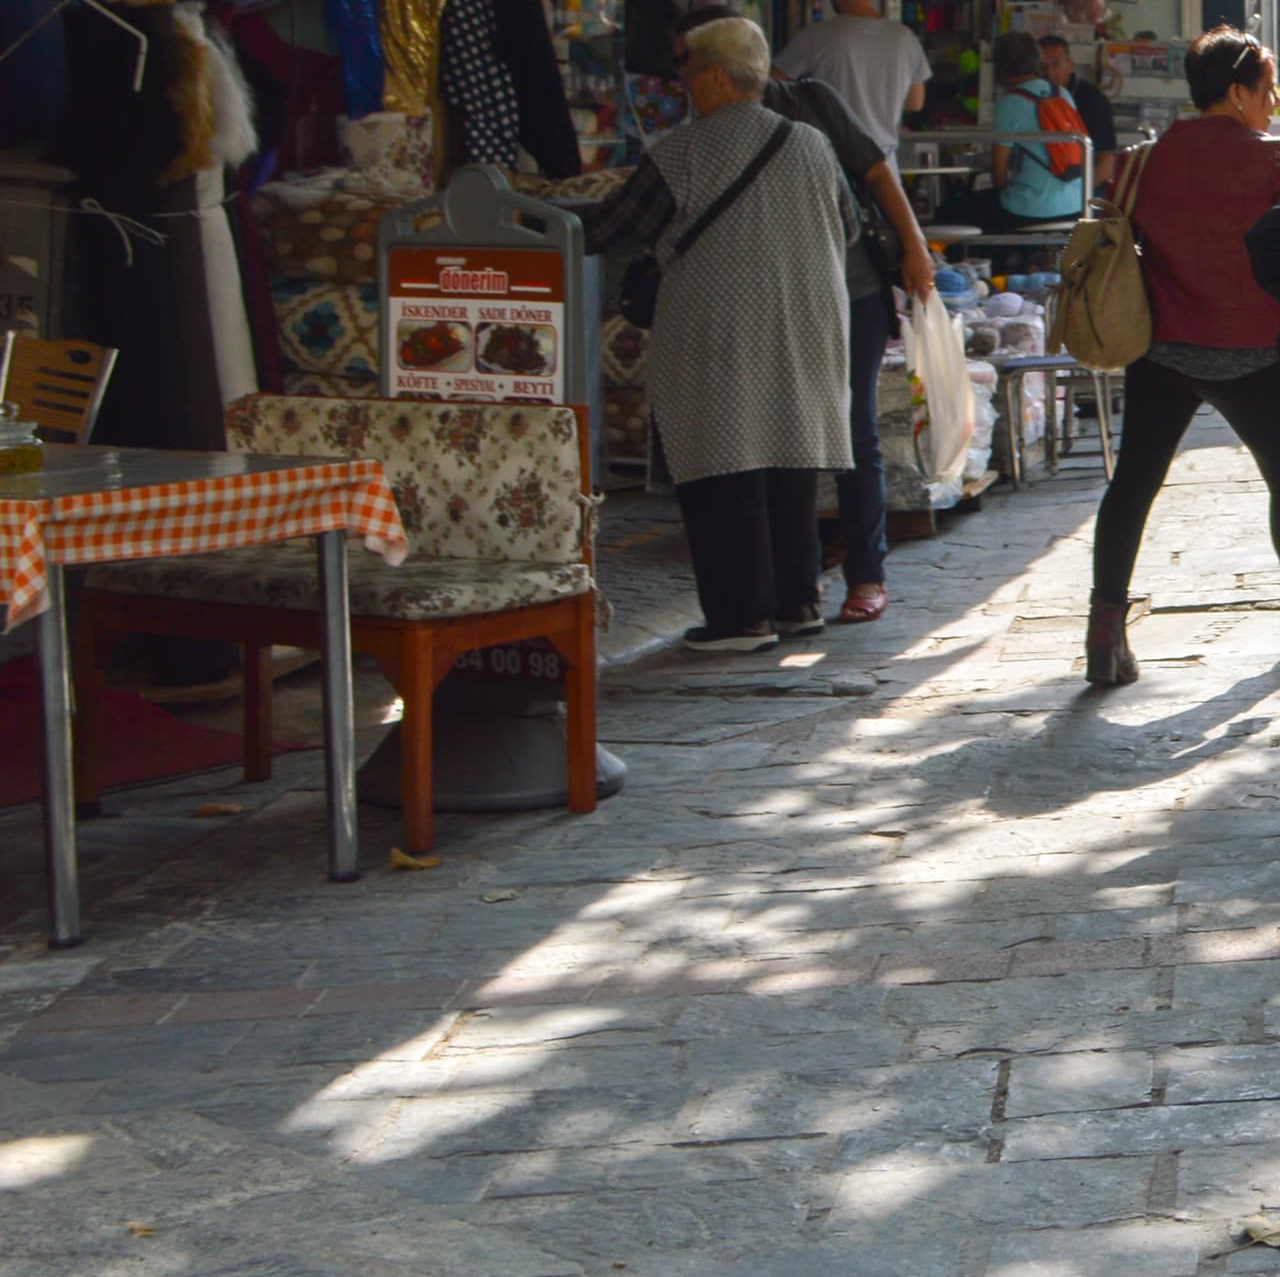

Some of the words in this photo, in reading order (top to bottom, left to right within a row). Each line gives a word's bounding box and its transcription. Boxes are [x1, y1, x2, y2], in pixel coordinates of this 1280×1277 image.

[402, 301, 468, 319] İSKENDER
[479, 307, 508, 321] SADE
[510, 304, 552, 322] DÖNER
[397, 373, 439, 389] KÖFTE
[512, 379, 555, 396] BEYTİ
[491, 648, 521, 674] 00
[528, 652, 560, 679] 98
